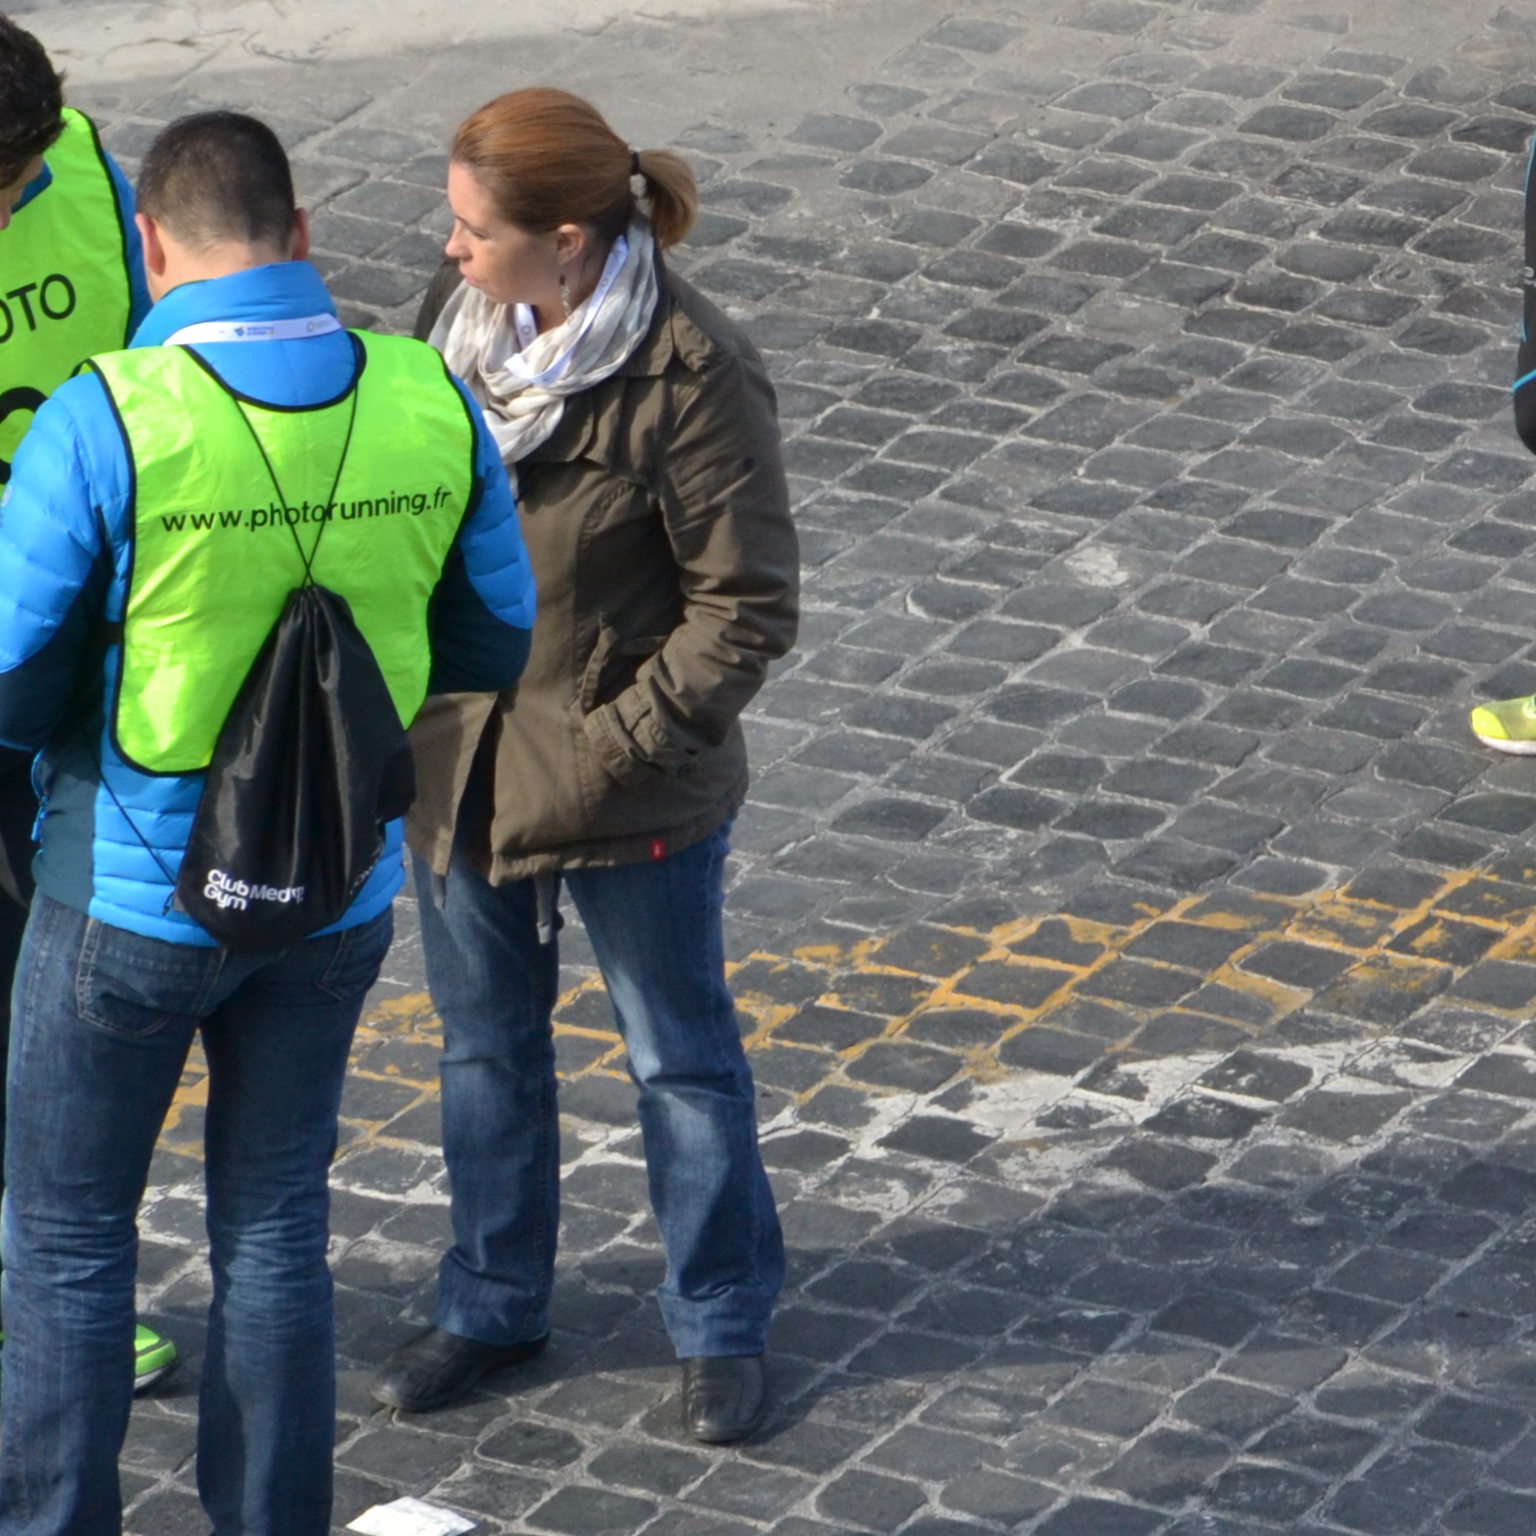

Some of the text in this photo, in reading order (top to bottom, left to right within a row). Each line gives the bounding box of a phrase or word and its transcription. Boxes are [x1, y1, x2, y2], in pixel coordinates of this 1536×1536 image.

[161, 485, 452, 533] www.photorunning.fr
[203, 883, 247, 911] Gym
[207, 869, 291, 903] Club Med
